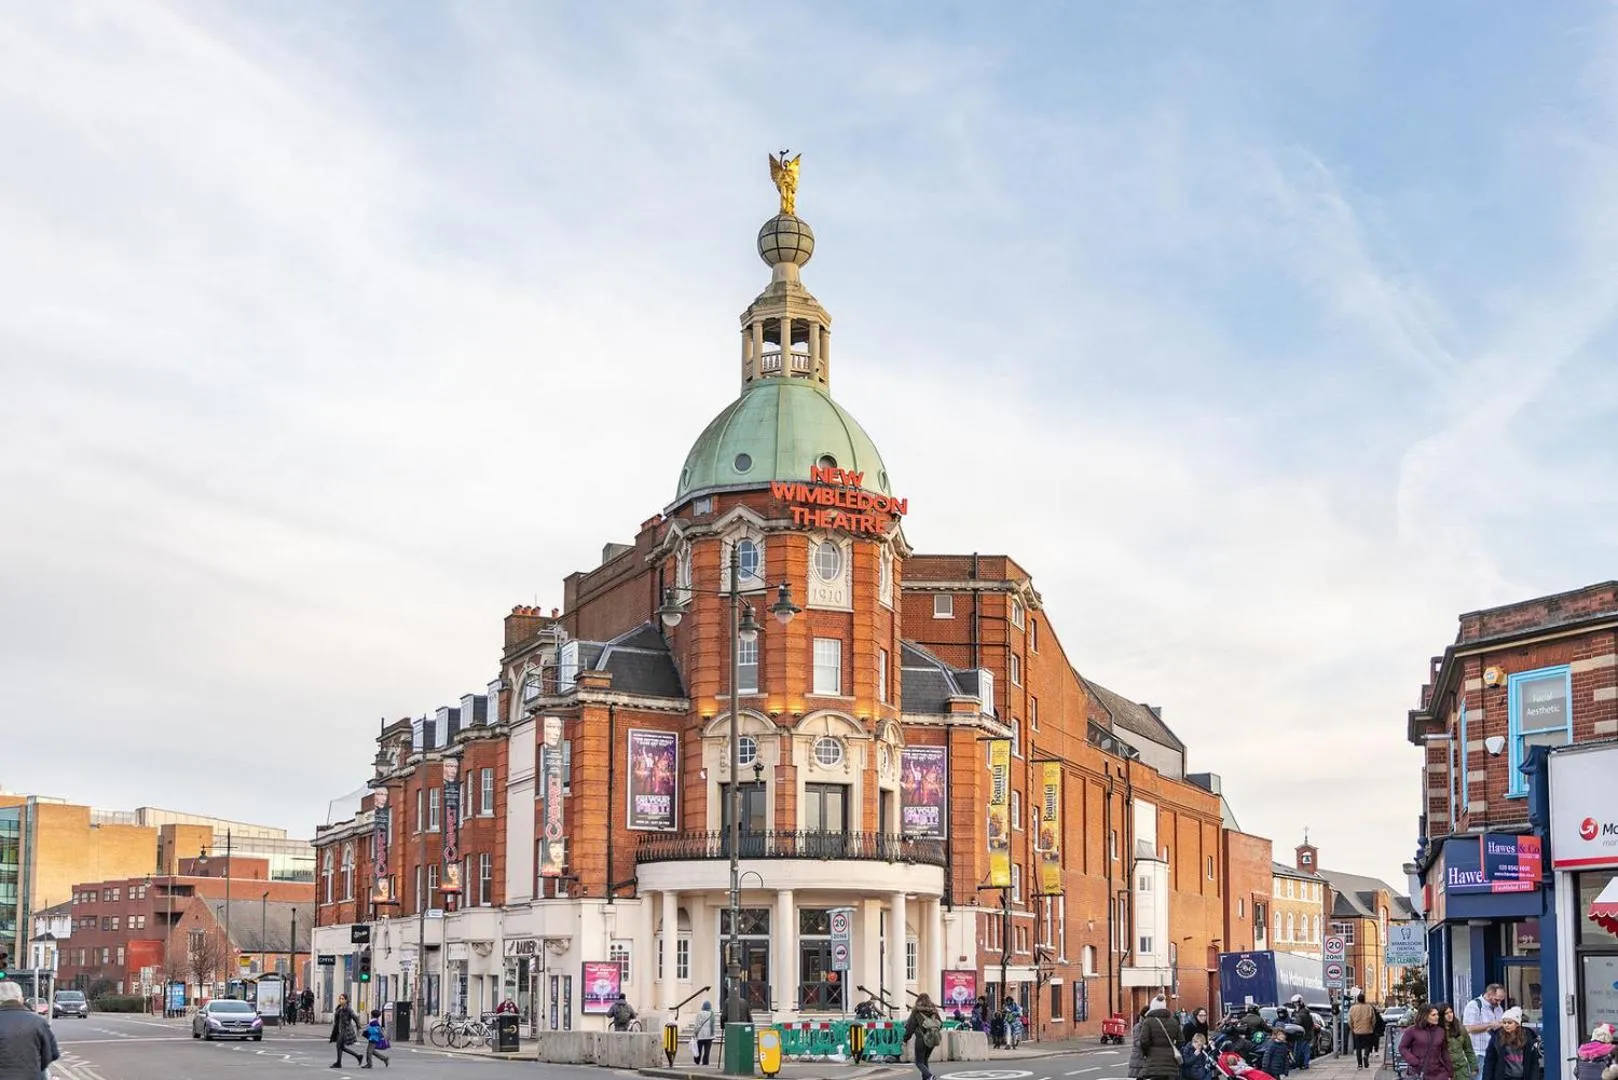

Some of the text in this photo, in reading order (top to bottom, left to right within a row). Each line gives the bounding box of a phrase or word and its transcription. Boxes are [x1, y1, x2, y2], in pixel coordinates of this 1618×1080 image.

[810, 466, 864, 488] NEW
[770, 480, 908, 516] WIMBLEDON
[790, 506, 892, 535] THEATRE
[813, 588, 843, 604] 1910
[991, 764, 1002, 806] Beautiful
[1044, 784, 1054, 822] Beautiful
[1488, 841, 1515, 854] Hawes
[1528, 845, 1540, 854] Co
[1448, 867, 1489, 884] Hawe
[835, 919, 845, 927] 20
